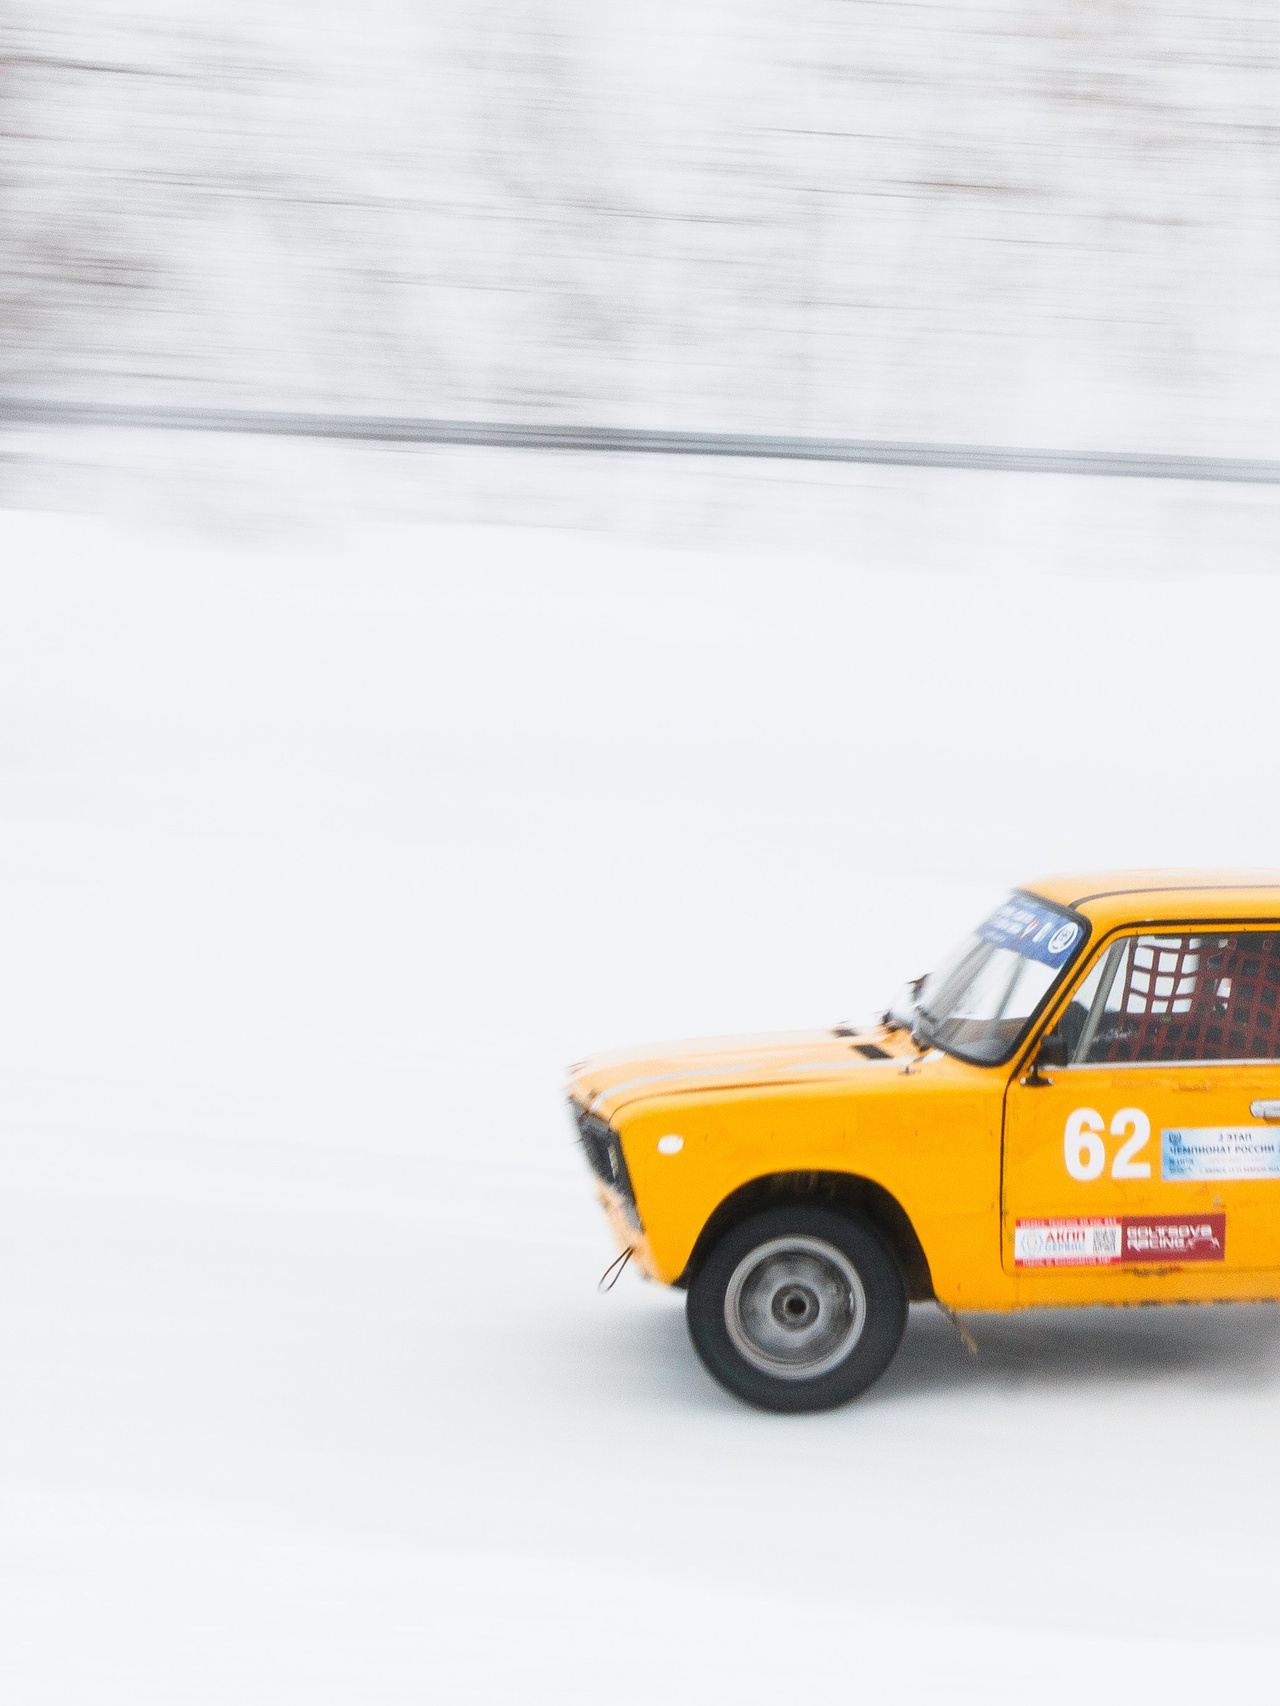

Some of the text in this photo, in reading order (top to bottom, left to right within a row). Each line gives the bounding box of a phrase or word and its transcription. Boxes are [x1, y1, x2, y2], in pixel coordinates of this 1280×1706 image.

[1227, 1132, 1253, 1142] ЭТАП
[1064, 1106, 1151, 1182] 62
[1169, 1144, 1232, 1156] ЧЕМПИОНАТ
[1234, 1143, 1275, 1155] РОССИИ
[1046, 1231, 1086, 1243] АКПП
